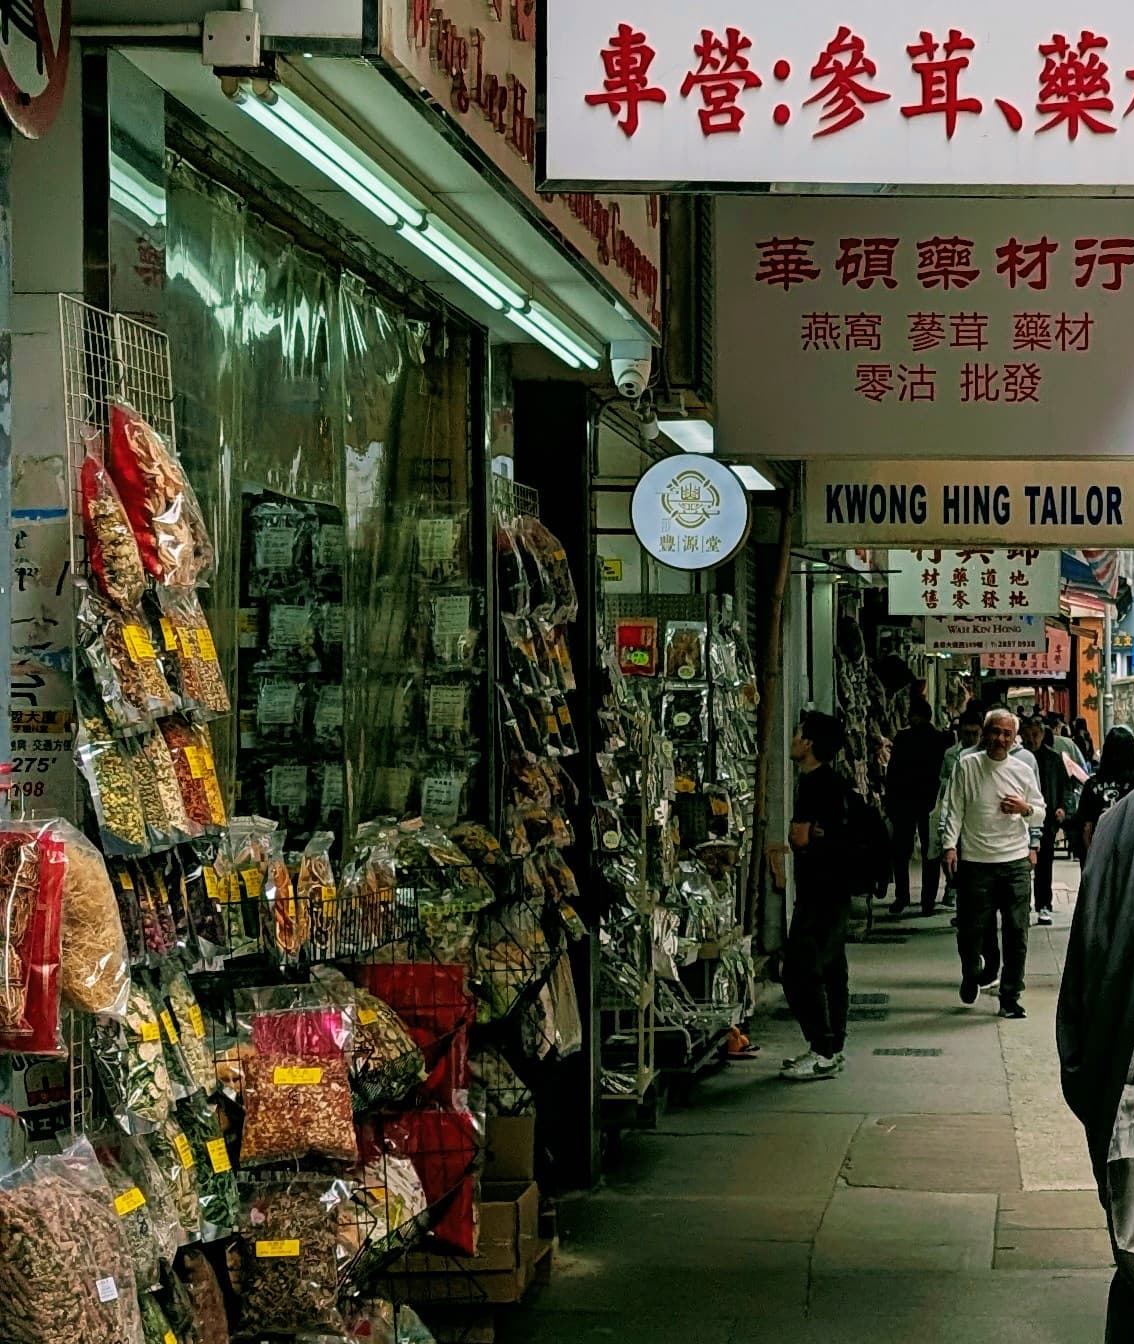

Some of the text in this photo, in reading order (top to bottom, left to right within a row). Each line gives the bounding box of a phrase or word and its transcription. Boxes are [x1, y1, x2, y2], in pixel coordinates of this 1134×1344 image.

[801, 311, 882, 351] 燕窩
[1012, 311, 1095, 352] 藥材
[854, 362, 1043, 403] 零沽 批發
[825, 485, 1124, 526] KWONG HING TAILOR
